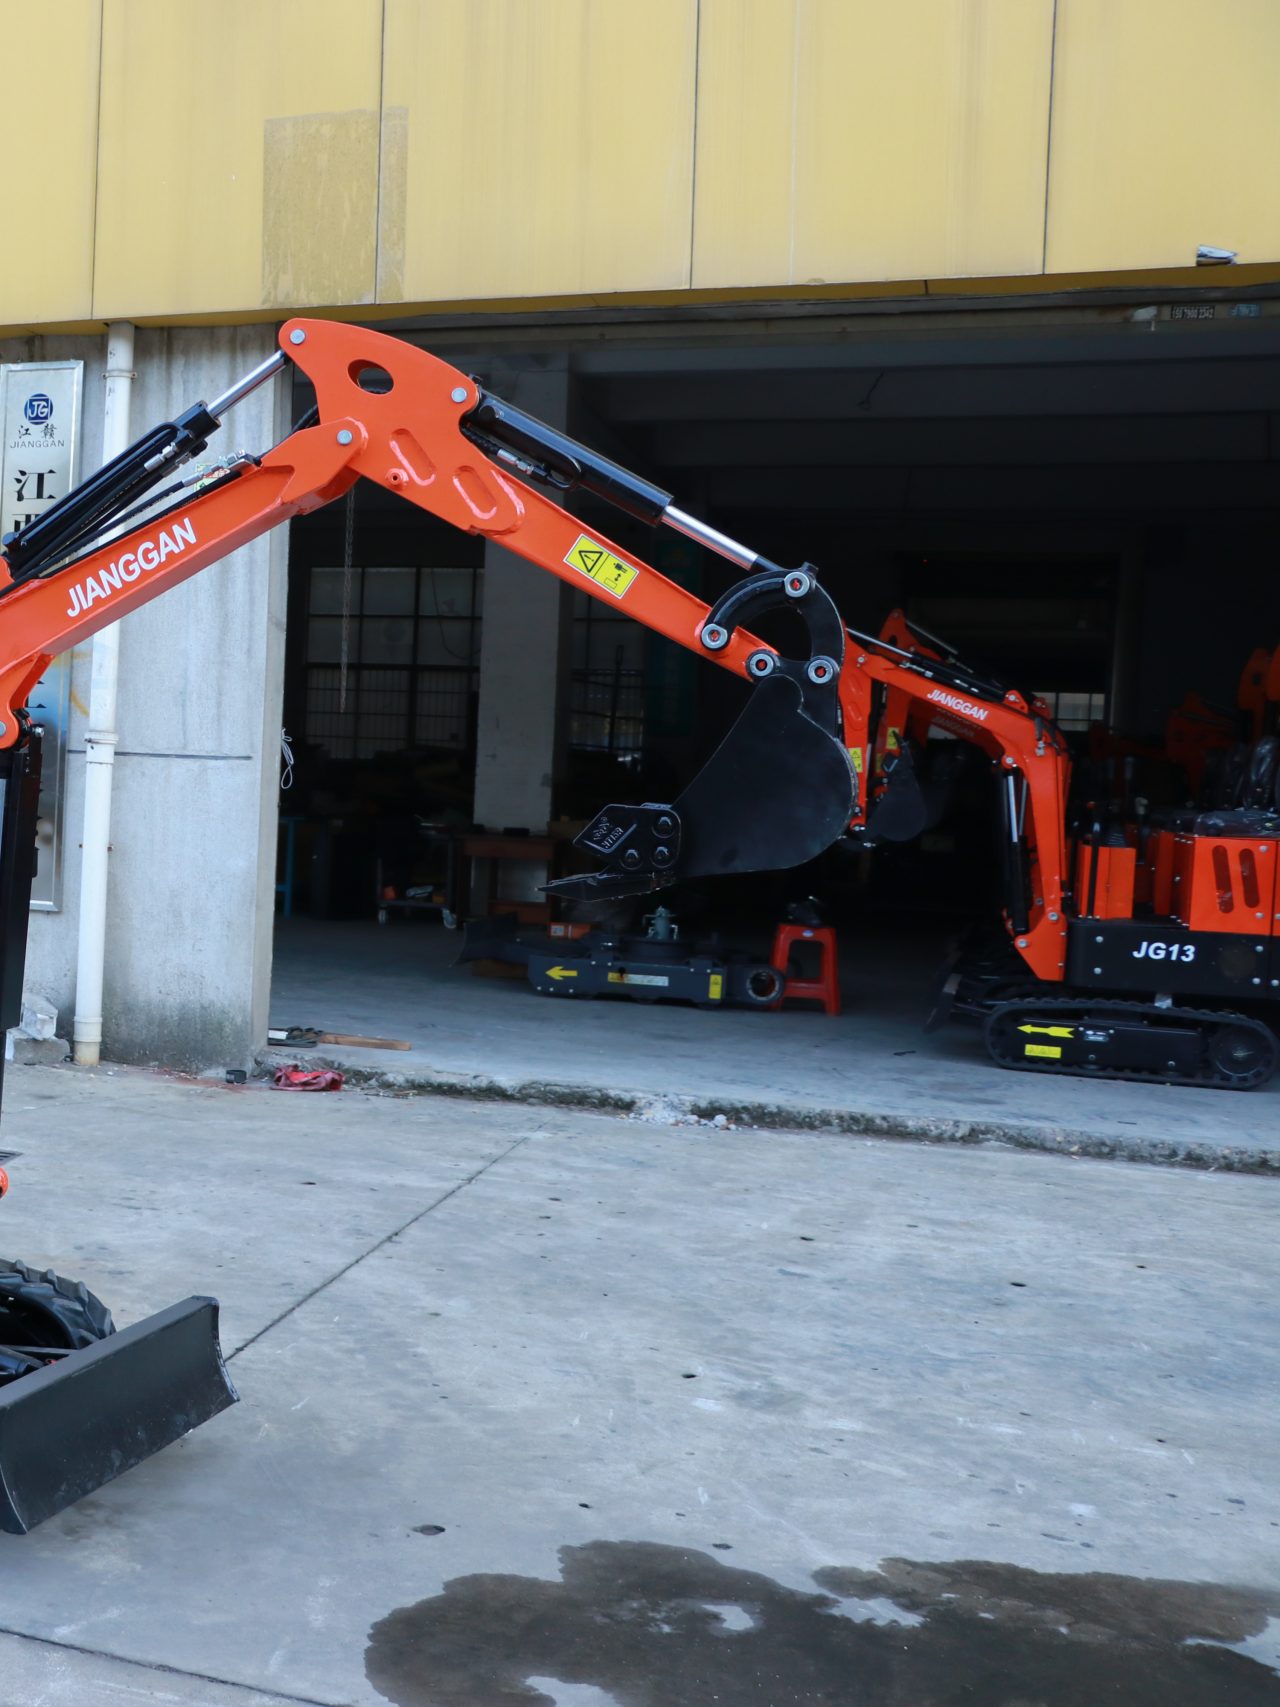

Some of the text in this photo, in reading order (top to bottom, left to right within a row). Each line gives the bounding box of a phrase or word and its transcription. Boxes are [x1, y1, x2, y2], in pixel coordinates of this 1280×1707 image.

[9, 439, 65, 449] JIANGGAN
[66, 517, 197, 618] JIANGGAN
[926, 688, 989, 721] JIANGGAN
[1131, 941, 1196, 962] JG13
